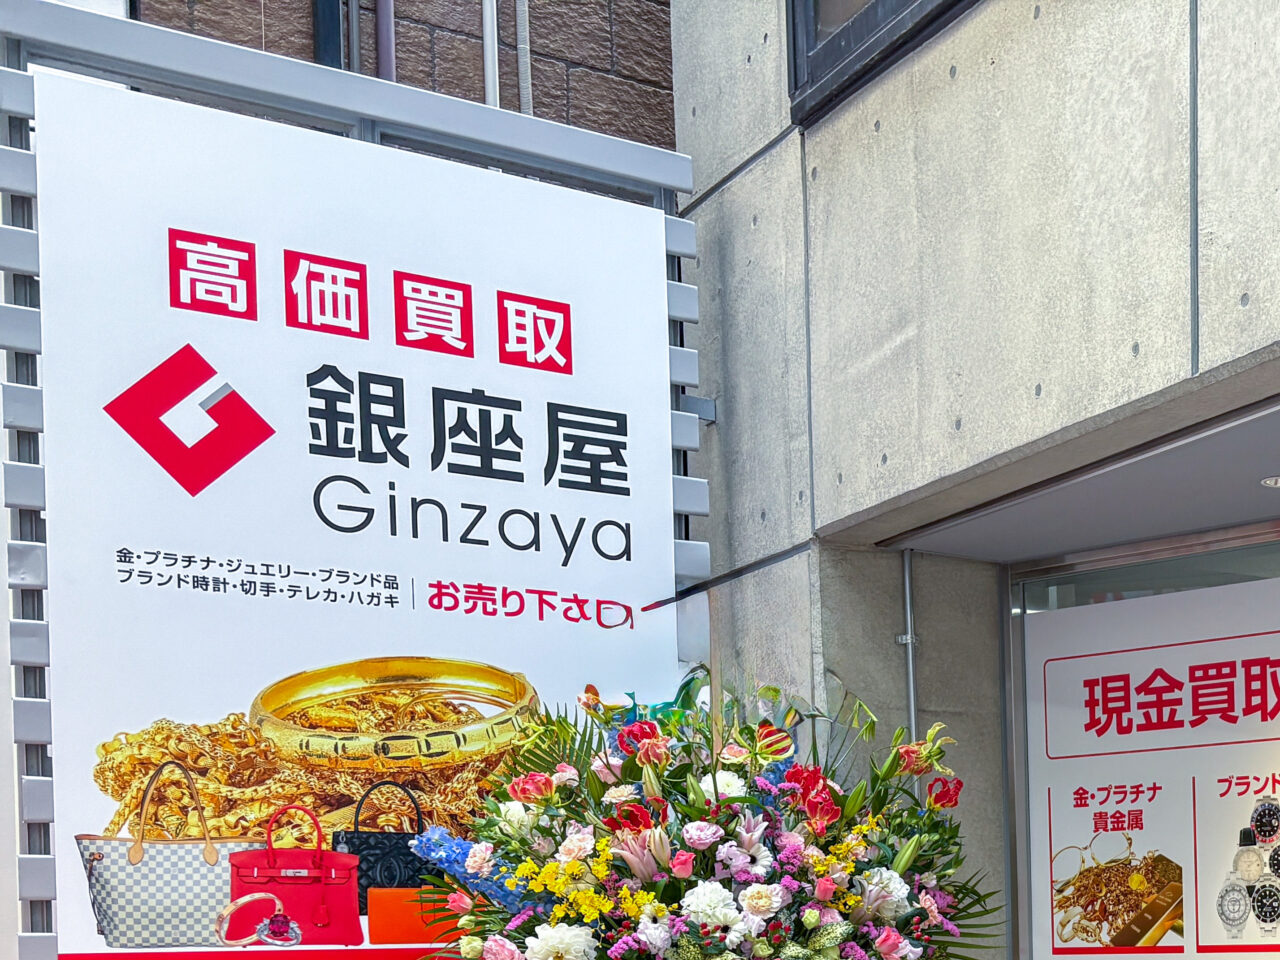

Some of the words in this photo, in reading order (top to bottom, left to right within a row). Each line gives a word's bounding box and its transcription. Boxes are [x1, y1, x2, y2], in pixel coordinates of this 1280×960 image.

[175, 240, 567, 369] 高価買取
[306, 363, 631, 497] 銀座屋
[312, 475, 632, 567] Ginzaya
[115, 547, 400, 591] 金・プラチナ・ジュエリー・ブランド品
[116, 568, 400, 609] ブランド時計・切手・テレカ・ハガキ
[1073, 782, 1163, 809] 金・プラチナ
[1093, 809, 1144, 833] 貴金属
